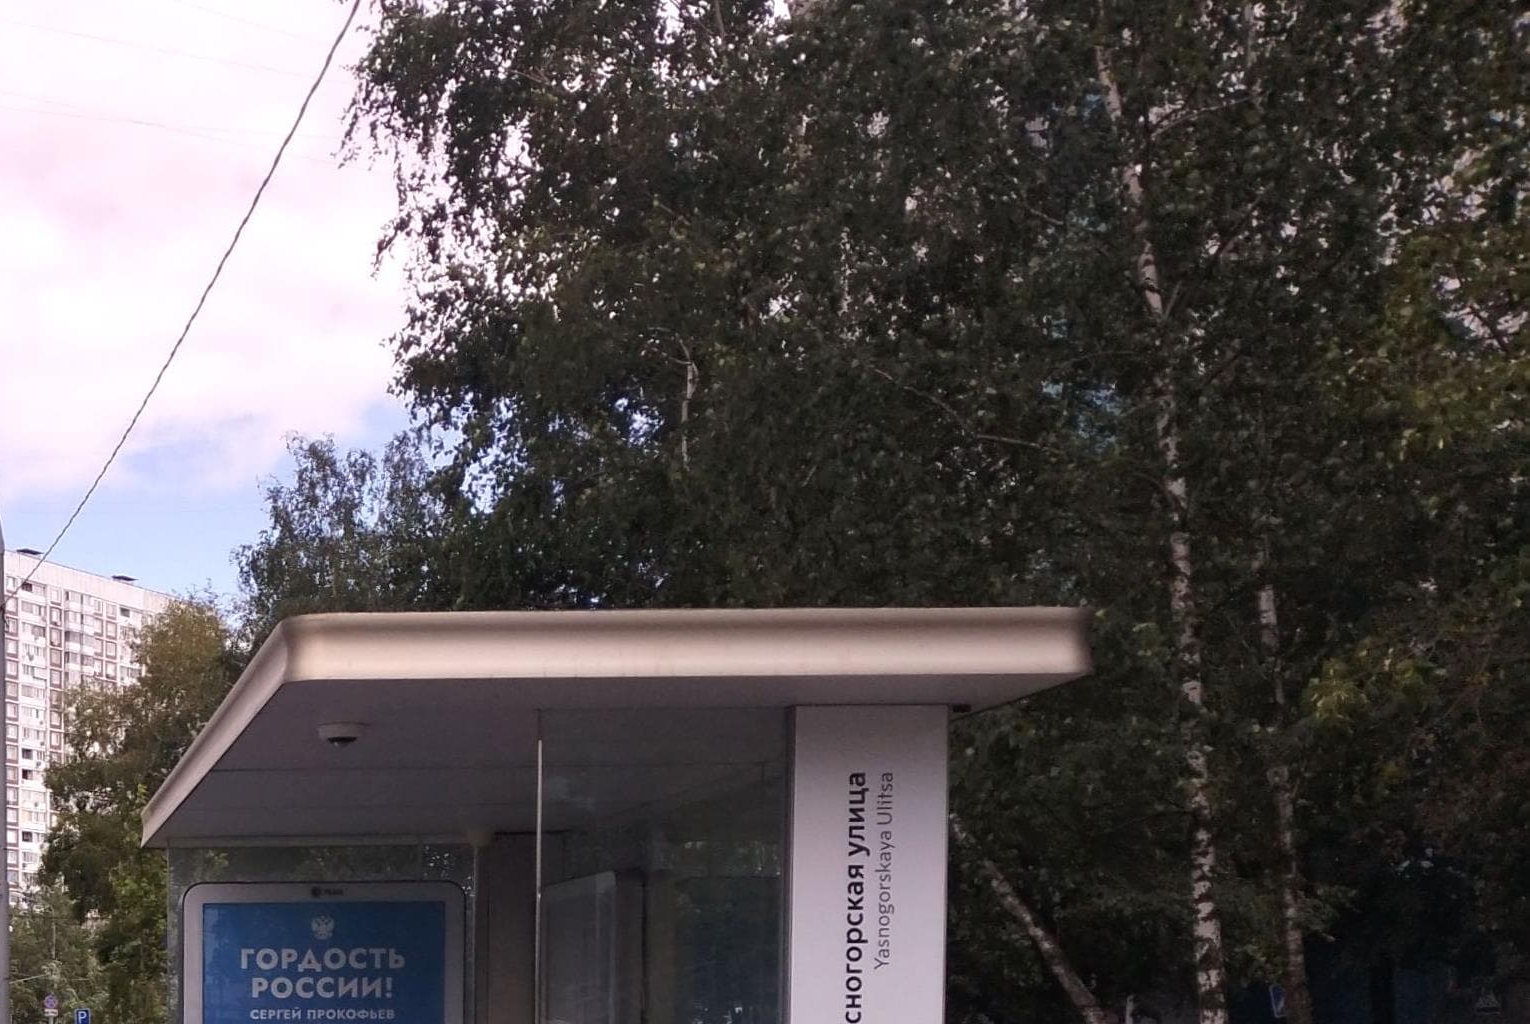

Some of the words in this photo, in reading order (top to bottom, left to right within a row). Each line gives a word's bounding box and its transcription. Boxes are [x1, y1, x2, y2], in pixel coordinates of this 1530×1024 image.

[847, 771, 870, 857] улица
[877, 771, 894, 826] Ulitsa
[874, 830, 895, 970] Yasnogorskaya
[240, 948, 406, 972] ГОРДОСТЬ
[251, 976, 393, 999] РОССИИ!
[250, 1006, 302, 1020] СЕРГЕЙ
[307, 1008, 396, 1020] ПРОКОФЬЕВ
